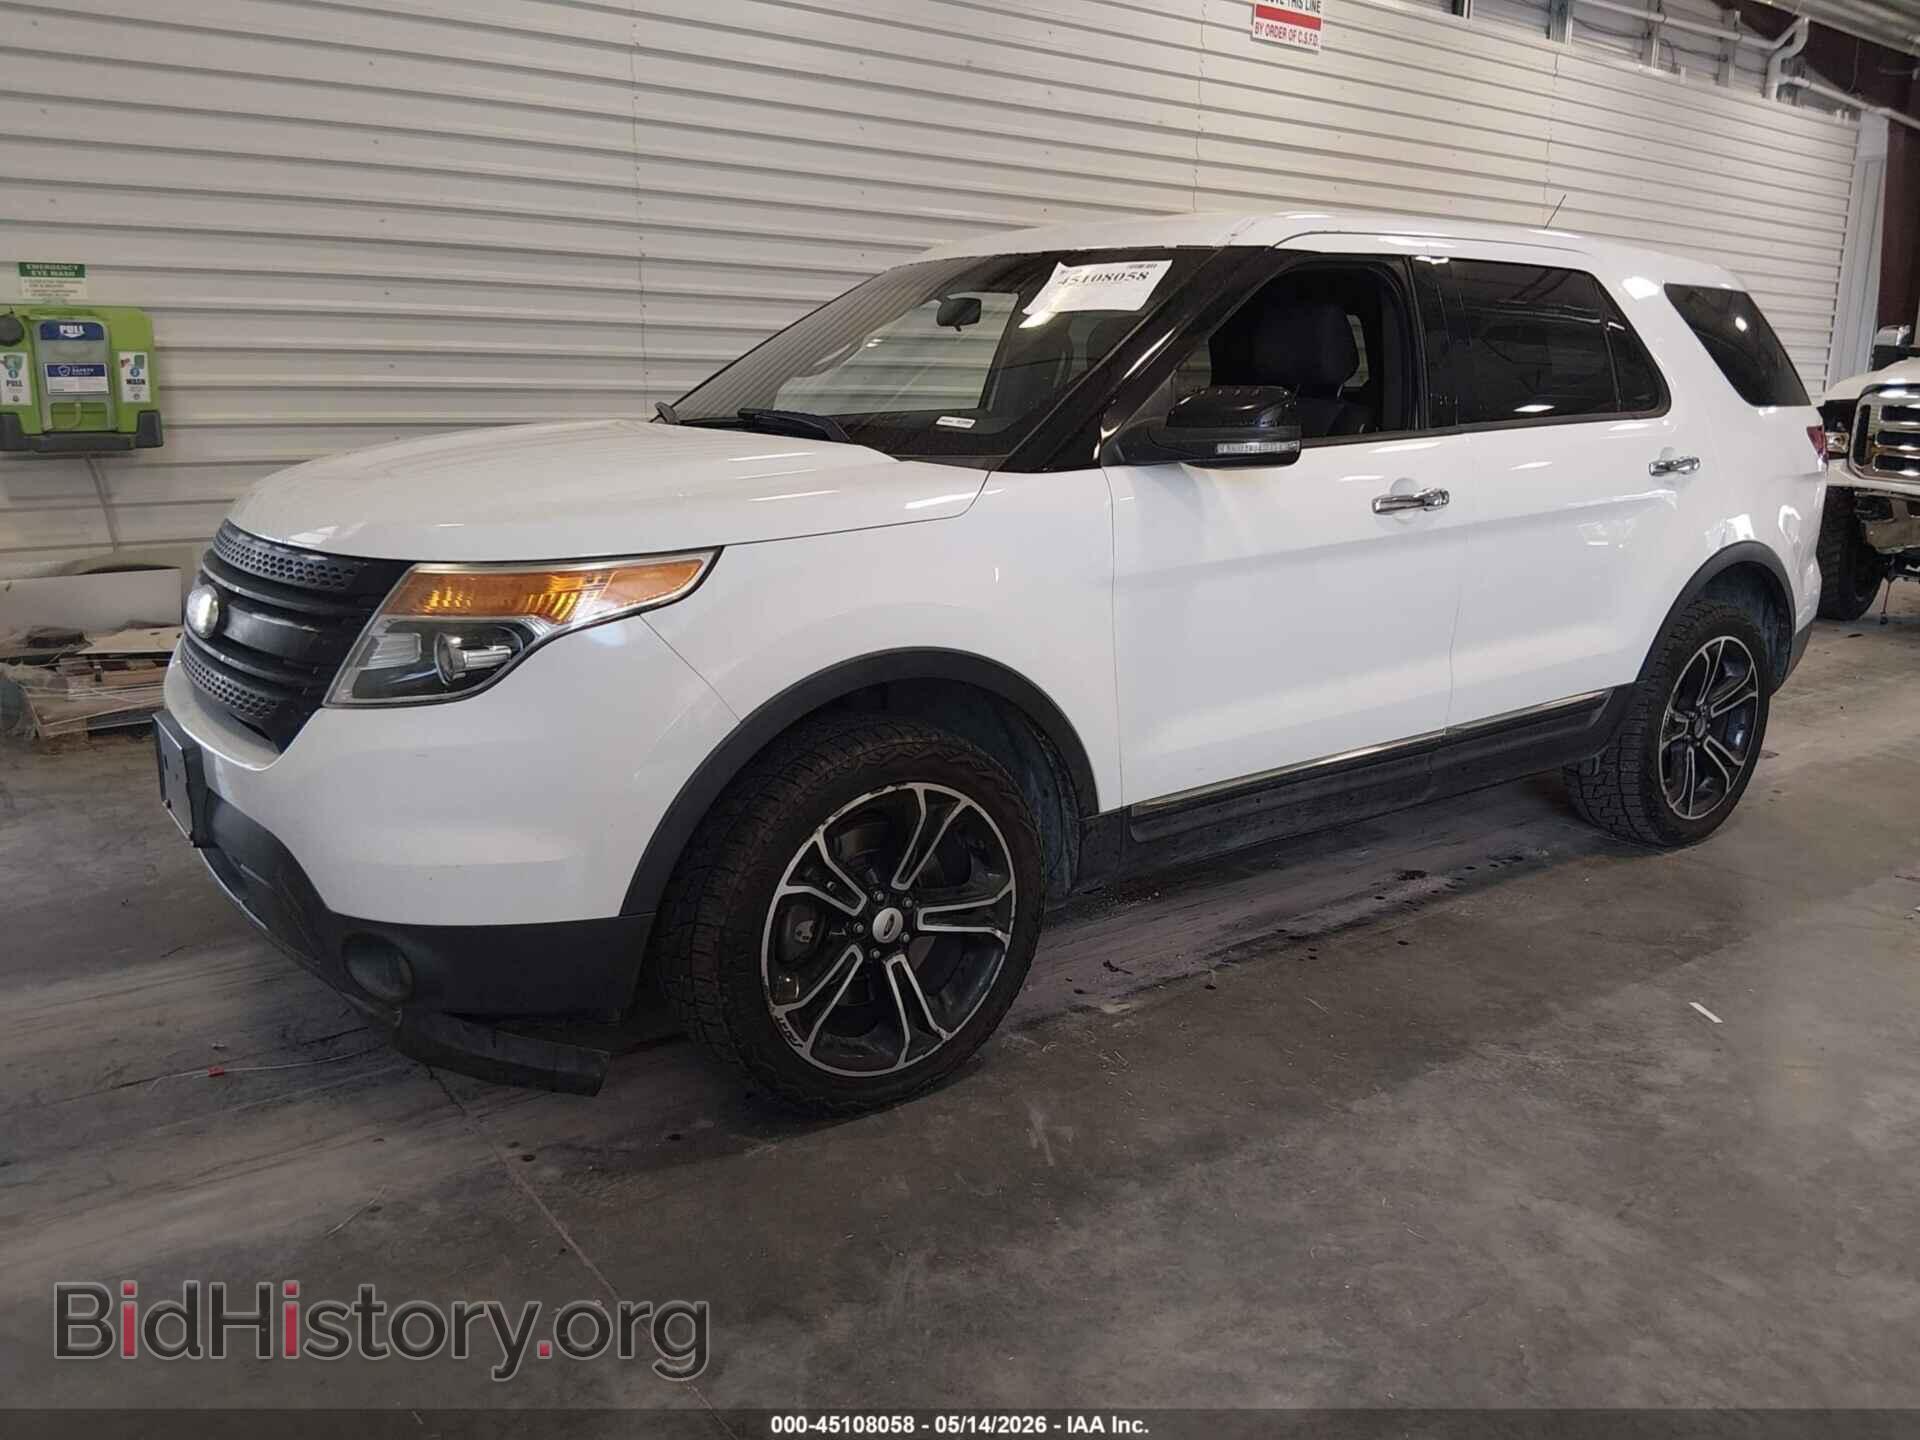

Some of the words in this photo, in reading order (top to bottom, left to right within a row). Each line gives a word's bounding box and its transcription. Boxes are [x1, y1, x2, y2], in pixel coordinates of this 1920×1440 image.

[1305, 0, 1321, 14] LINE
[1255, 22, 1264, 35] BY
[1264, 23, 1287, 40] ORDER
[1288, 28, 1296, 41] OF
[59, 324, 85, 335] PULL
